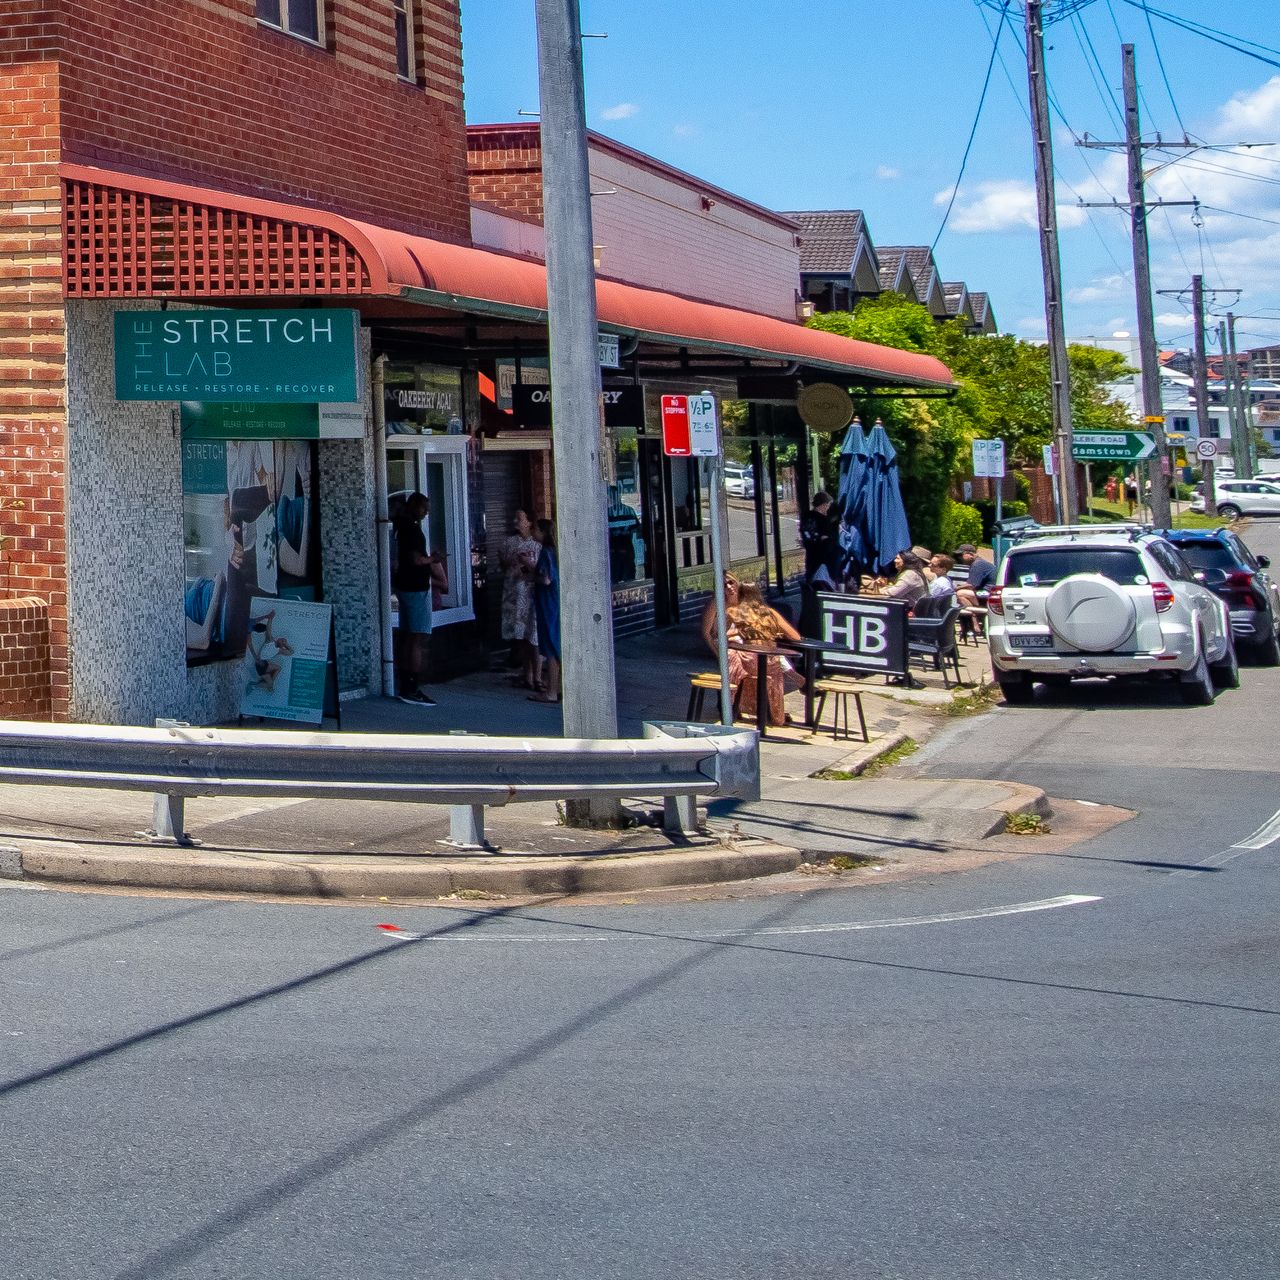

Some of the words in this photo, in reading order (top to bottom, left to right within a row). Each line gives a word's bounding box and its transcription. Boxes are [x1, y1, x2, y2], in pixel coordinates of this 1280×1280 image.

[162, 318, 333, 344] STRETCH
[134, 320, 153, 379] THE
[164, 351, 233, 377] LAB
[135, 384, 189, 393] RELEASE
[204, 384, 260, 393] RESTORE
[276, 384, 335, 393] RECOVER
[398, 390, 435, 409] OAKBERRY
[435, 392, 452, 414] AÇAI
[186, 443, 224, 460] STRETCH
[1072, 446, 1131, 456] damstown
[1201, 444, 1213, 453] 50
[287, 609, 328, 620] STRETCH
[823, 612, 888, 653] HB
